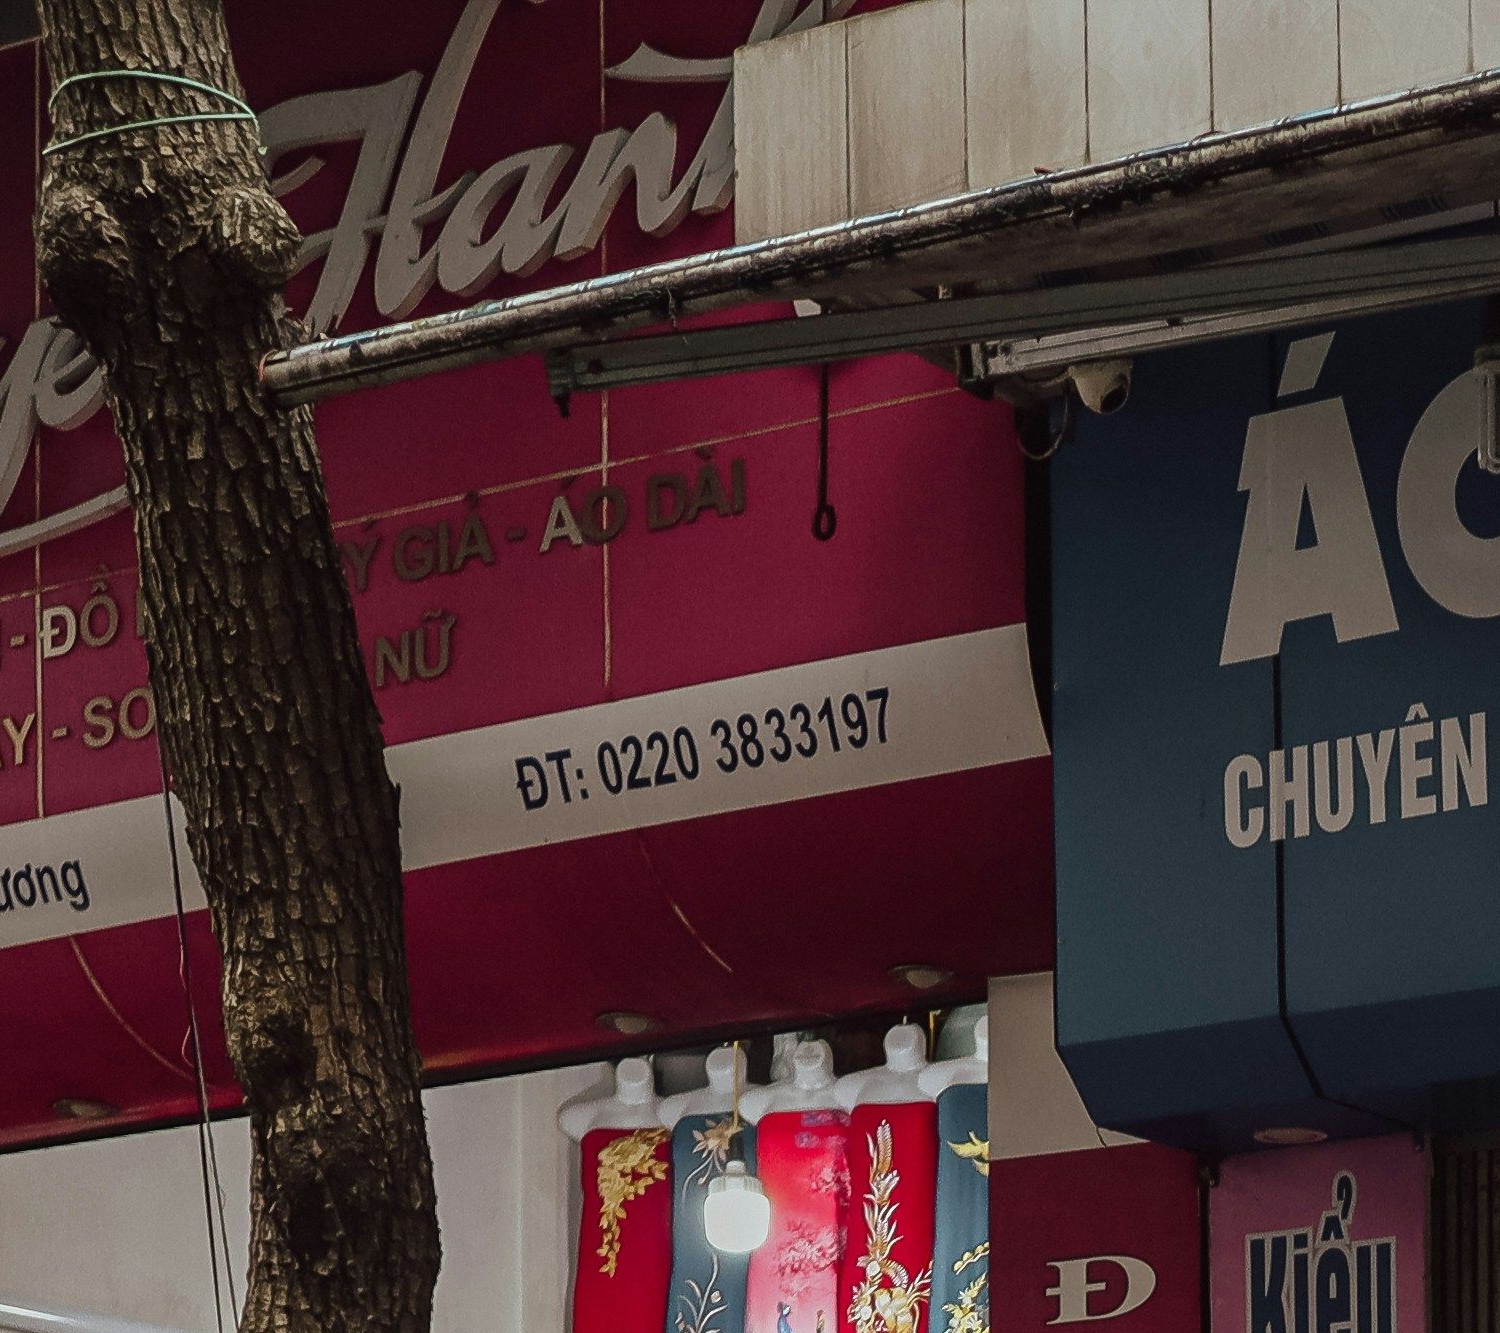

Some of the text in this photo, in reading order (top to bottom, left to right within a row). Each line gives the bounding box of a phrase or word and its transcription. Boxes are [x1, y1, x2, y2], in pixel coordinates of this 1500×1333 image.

[539, 475, 628, 554] ÁO
[646, 446, 747, 533] DÀI
[39, 564, 120, 661] ĐỒ
[375, 608, 459, 690] NỮ
[513, 686, 891, 812] ĐT: 0220 3833197
[1222, 700, 1488, 848] CHUYÊN
